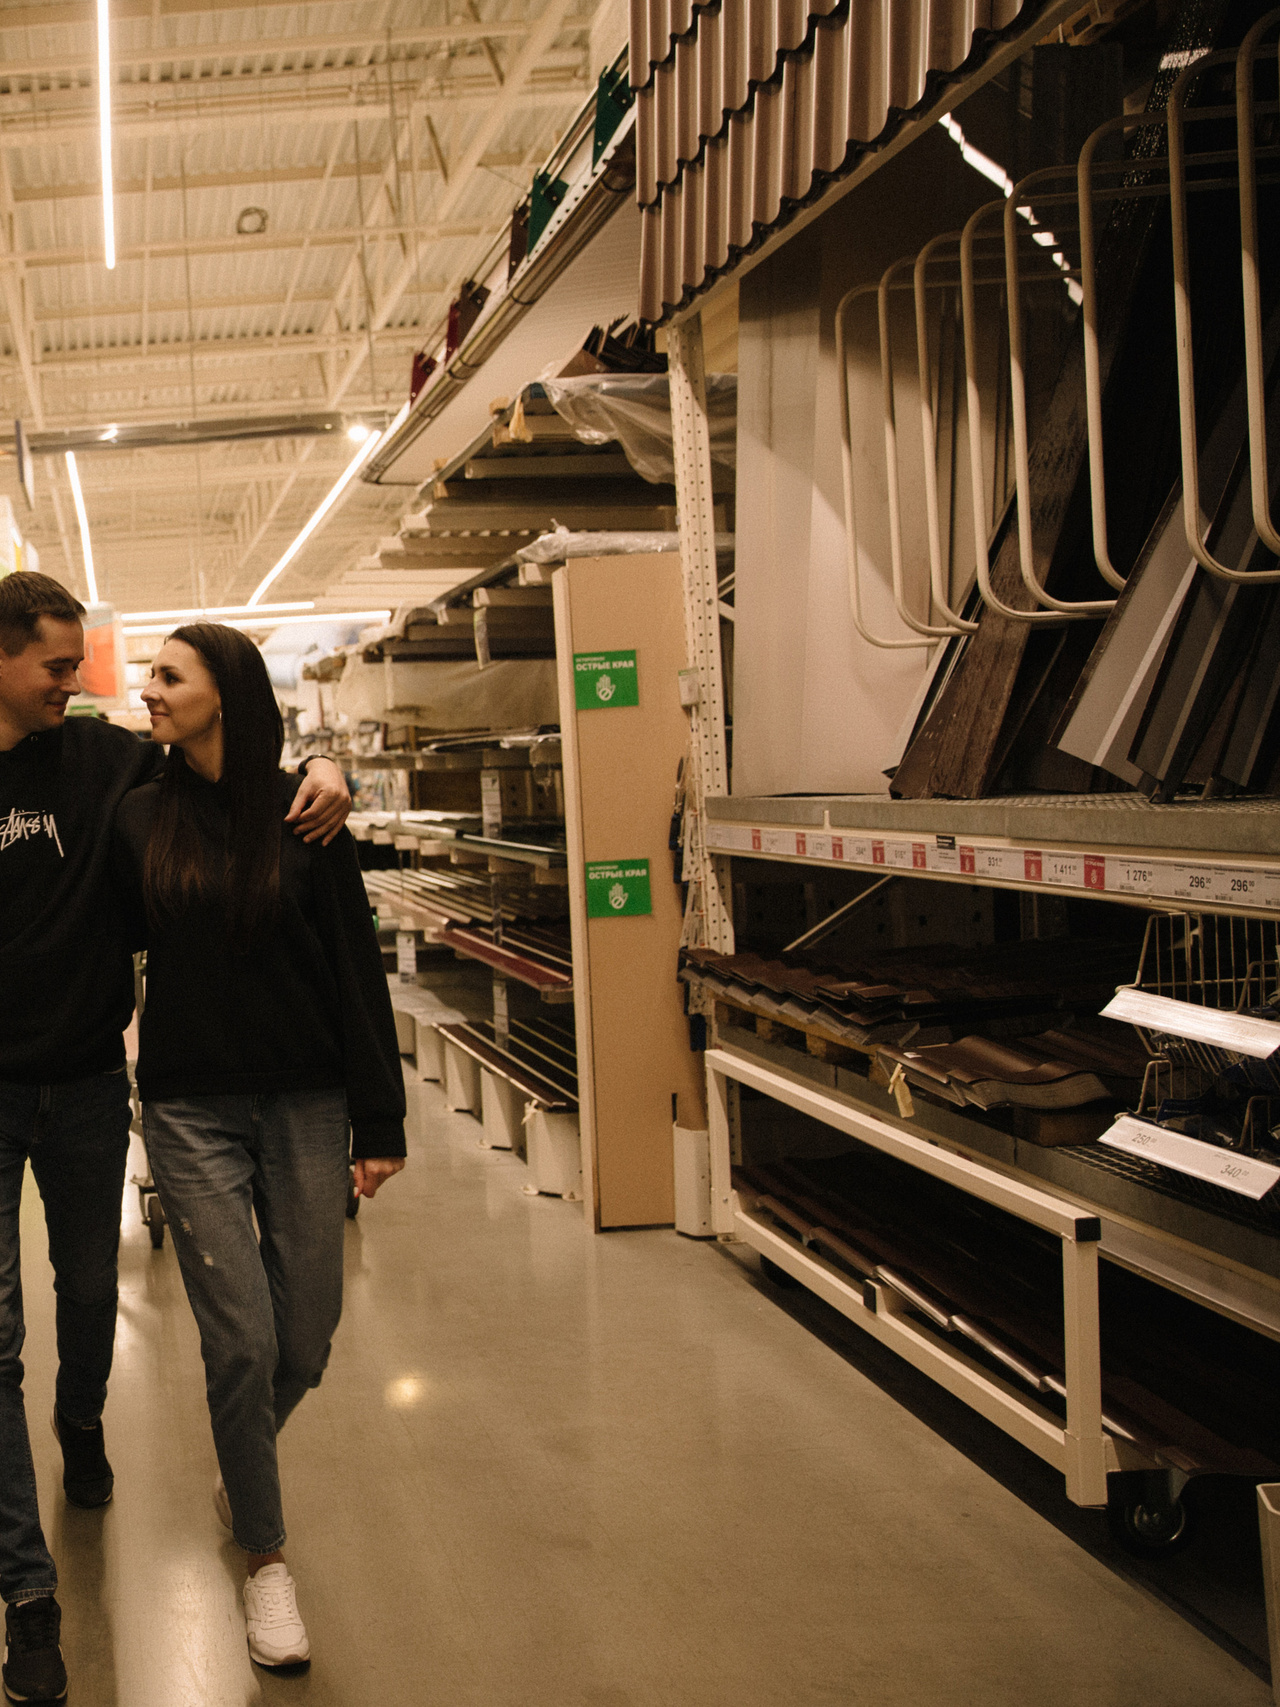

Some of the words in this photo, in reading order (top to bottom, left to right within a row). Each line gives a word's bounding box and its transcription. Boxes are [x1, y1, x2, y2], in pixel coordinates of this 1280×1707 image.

[576, 661, 610, 671] ОСТРЫЕ
[612, 660, 634, 668] КРАЯ
[589, 870, 623, 879] ОСТРЫЕ
[1189, 876, 1205, 888] 296
[1231, 879, 1248, 892] 296
